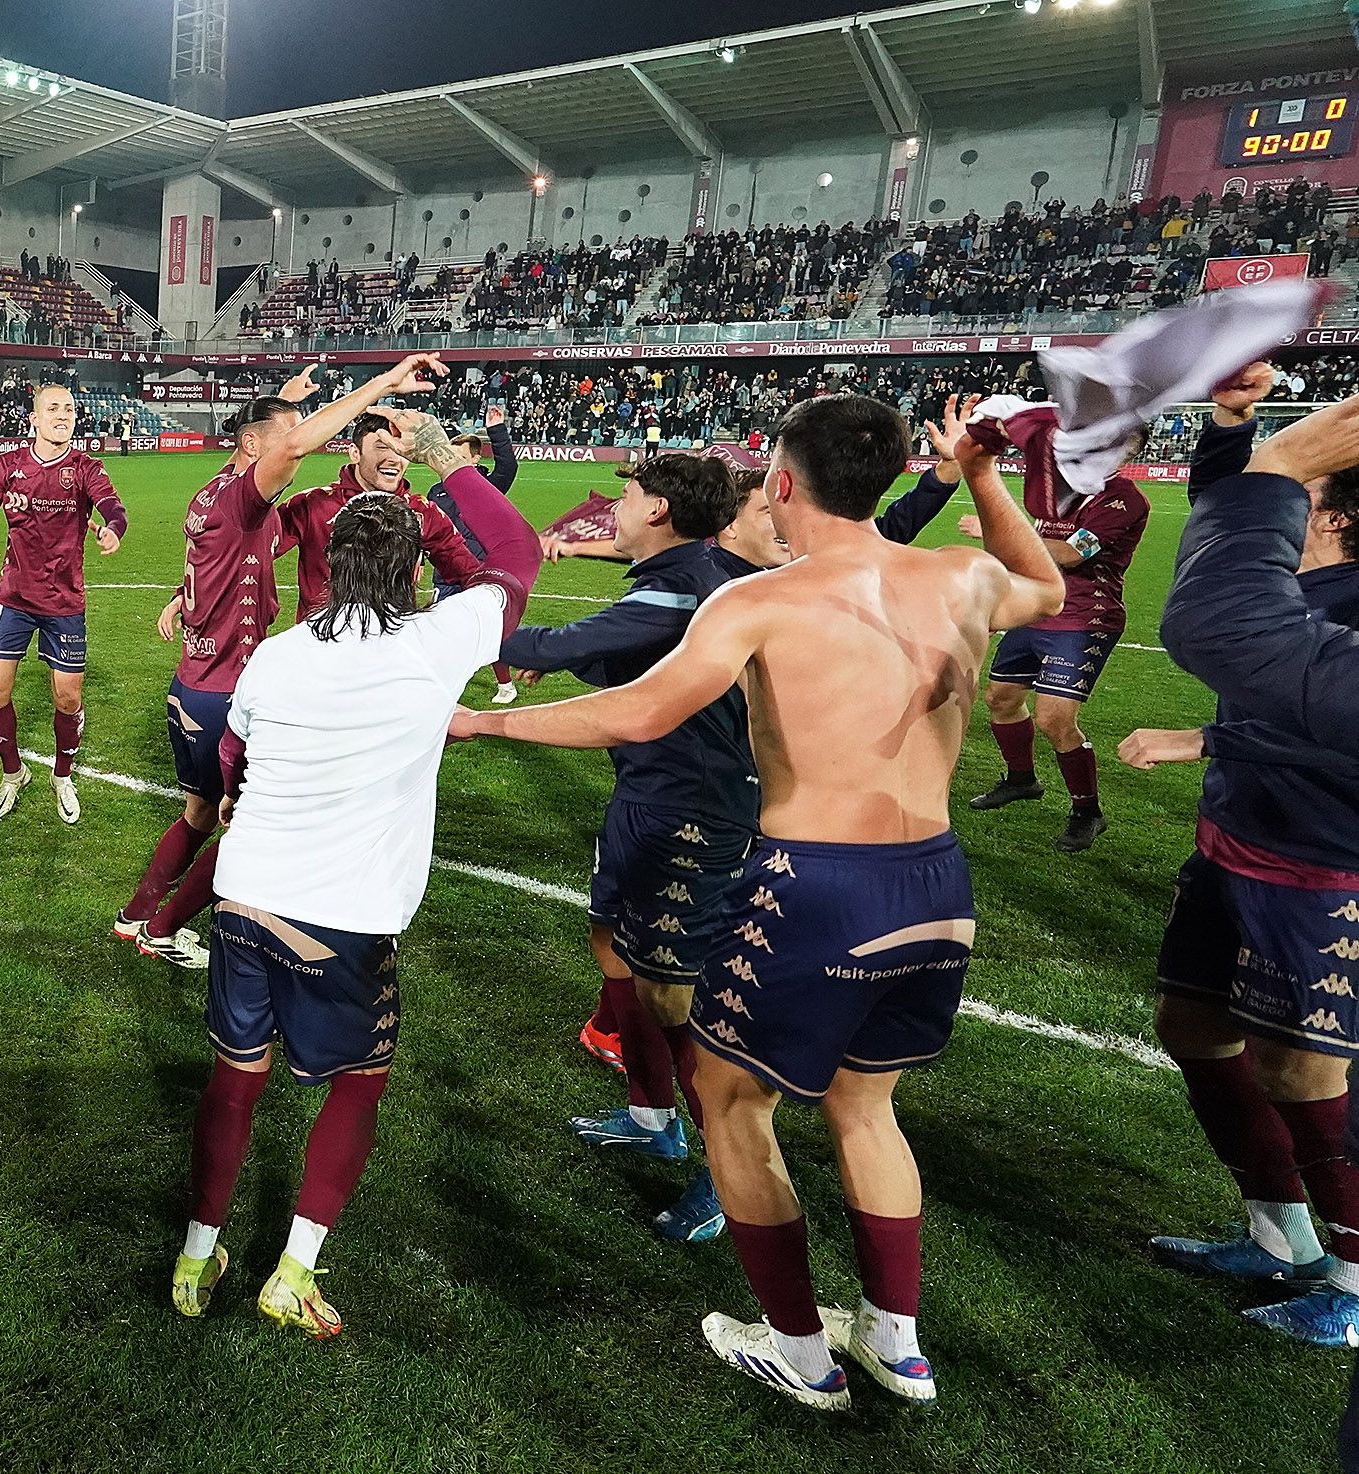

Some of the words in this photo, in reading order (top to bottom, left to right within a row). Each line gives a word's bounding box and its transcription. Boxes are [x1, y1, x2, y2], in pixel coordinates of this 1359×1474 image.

[1181, 80, 1255, 100] FORZA
[1248, 108, 1260, 128] 1
[1325, 98, 1347, 120] 0
[1242, 129, 1332, 157] 90:00
[94, 351, 113, 360] Barca
[552, 346, 633, 359] CONSERVAS
[641, 343, 730, 358] PESCAMAR
[168, 385, 204, 394] Deputación
[168, 391, 204, 400] Pontevedra
[230, 386, 254, 394] Deputación
[519, 448, 597, 462] ABANCA
[1147, 466, 1169, 478] COPA
[31, 497, 77, 507] Deputación
